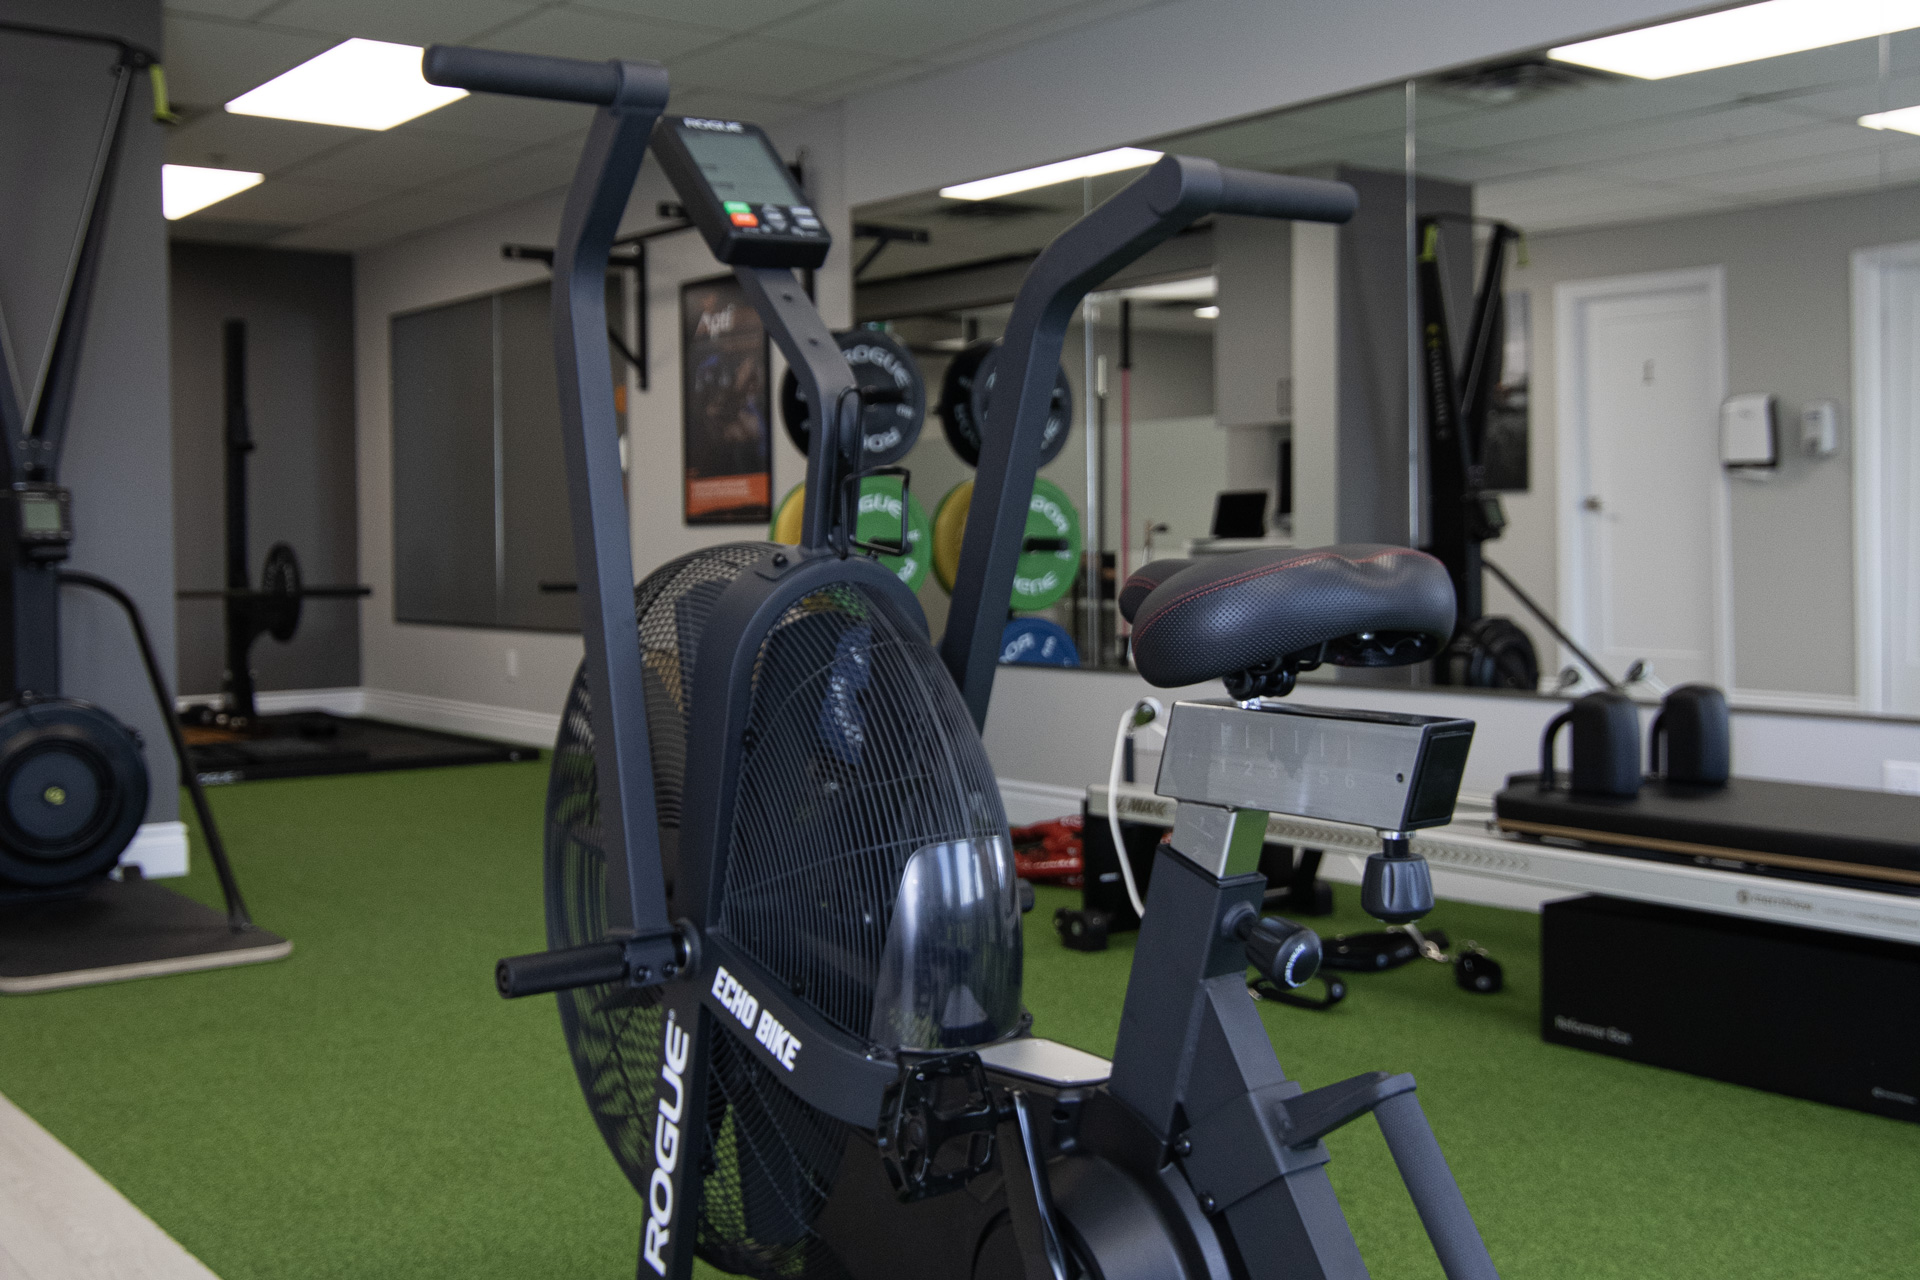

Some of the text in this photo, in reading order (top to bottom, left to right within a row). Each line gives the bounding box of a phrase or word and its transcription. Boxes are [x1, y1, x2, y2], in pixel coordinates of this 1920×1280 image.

[683, 117, 745, 133] ROGUE
[711, 965, 803, 1073] ECHO BIKE
[643, 1018, 690, 1278] ROGUE
